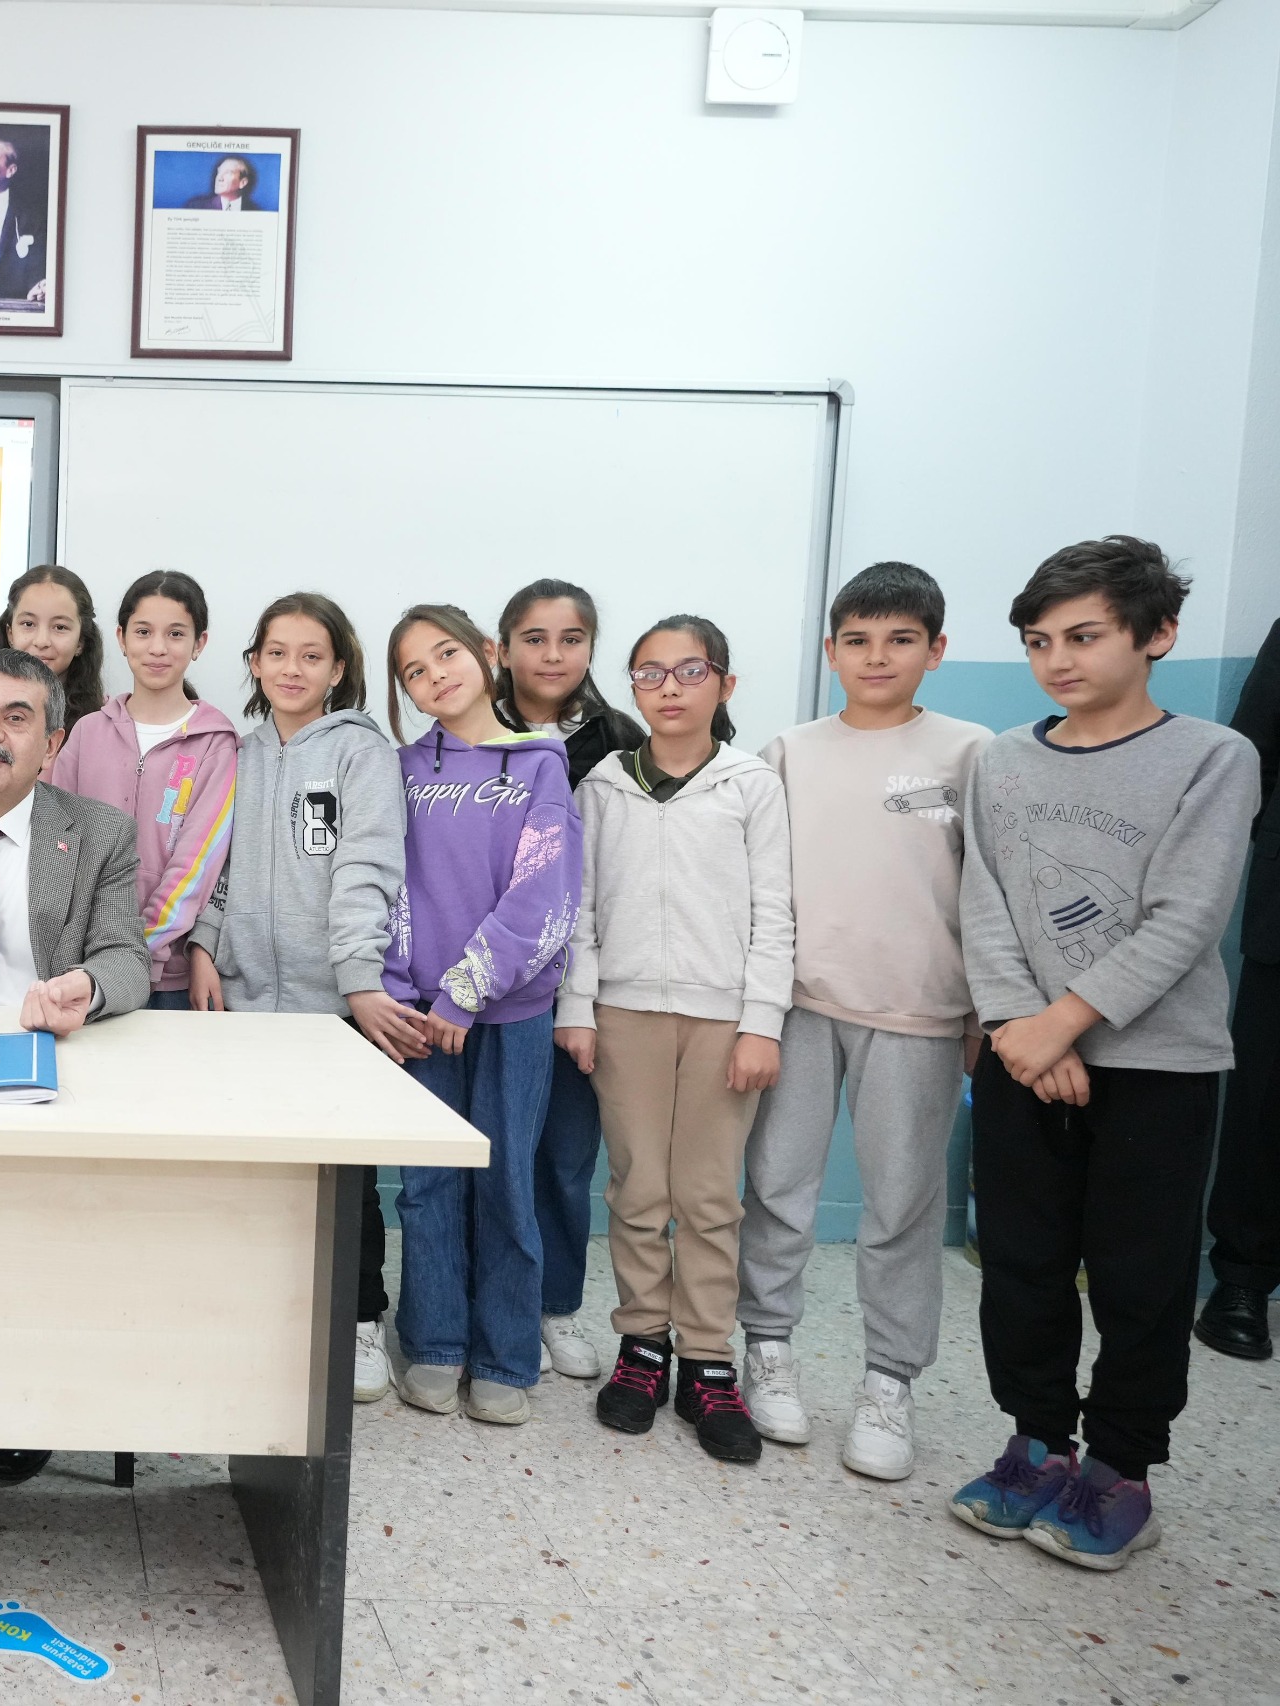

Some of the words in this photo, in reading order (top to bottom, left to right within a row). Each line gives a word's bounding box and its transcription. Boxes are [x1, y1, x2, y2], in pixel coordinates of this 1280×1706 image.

[992, 812, 1018, 839] LC
[1025, 803, 1147, 848] WAIKIKI
[41, 1642, 92, 1677] Potasyum
[50, 1637, 99, 1669] Hidroksit
